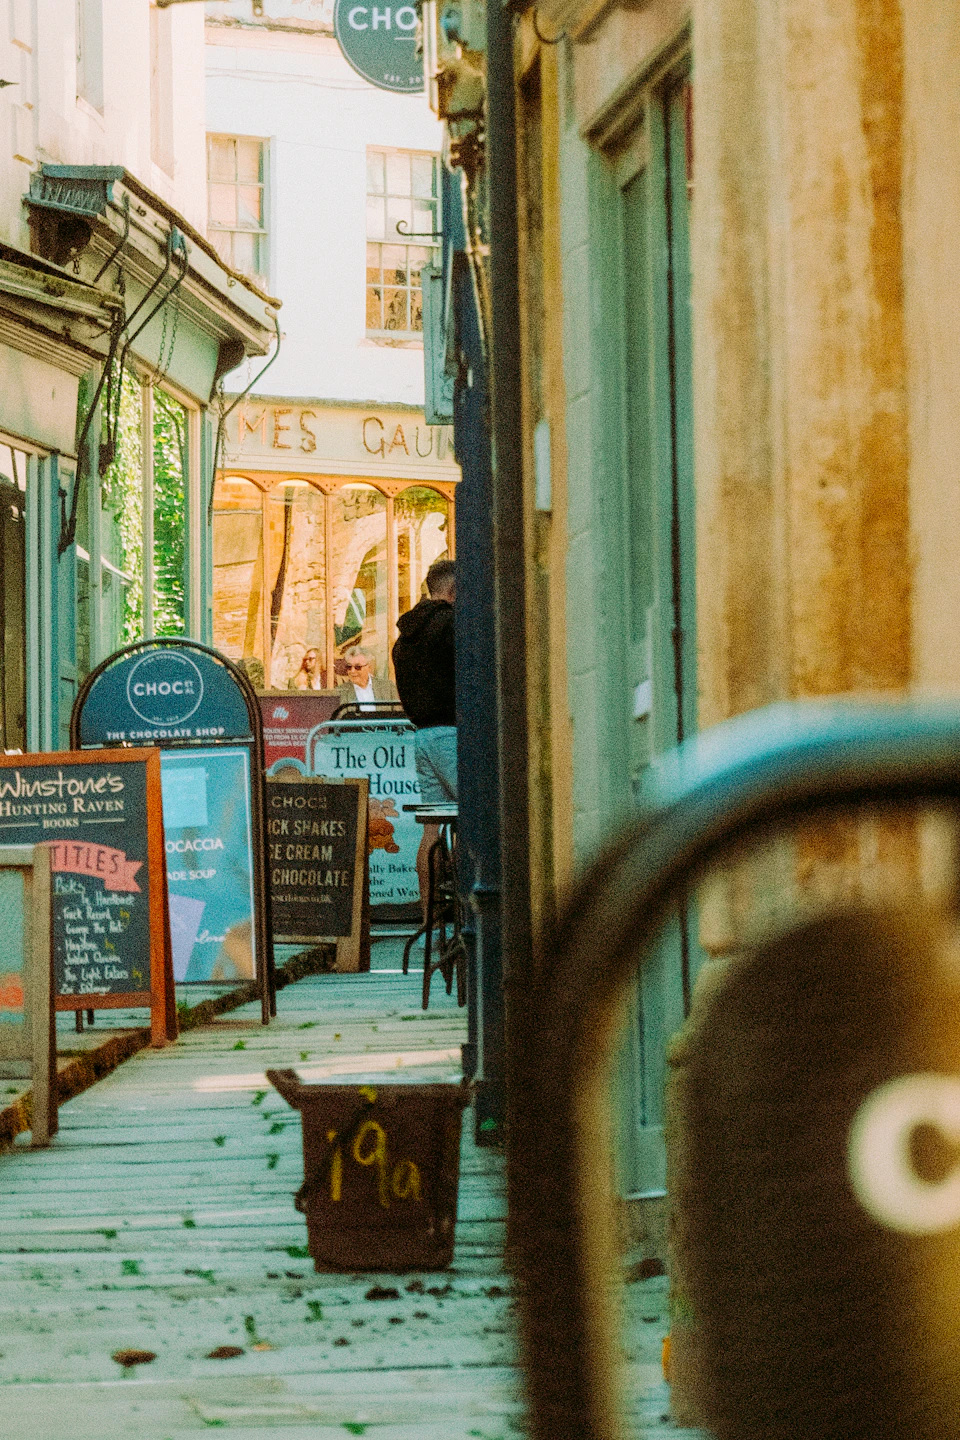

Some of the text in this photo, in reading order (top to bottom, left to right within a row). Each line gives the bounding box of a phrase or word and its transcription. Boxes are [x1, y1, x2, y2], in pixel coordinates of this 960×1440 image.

[224, 408, 317, 453] MES
[133, 681, 184, 696] CHOC
[106, 727, 225, 740] THE CHOCOLATE SHOP
[331, 746, 405, 769] The Old
[73, 797, 124, 813] RAVEN
[42, 818, 80, 829] BOOKS
[293, 820, 347, 837] SHAKES
[286, 844, 333, 861] CREAM
[189, 869, 217, 881] SOUP
[272, 868, 349, 887] CHOCOLATE
